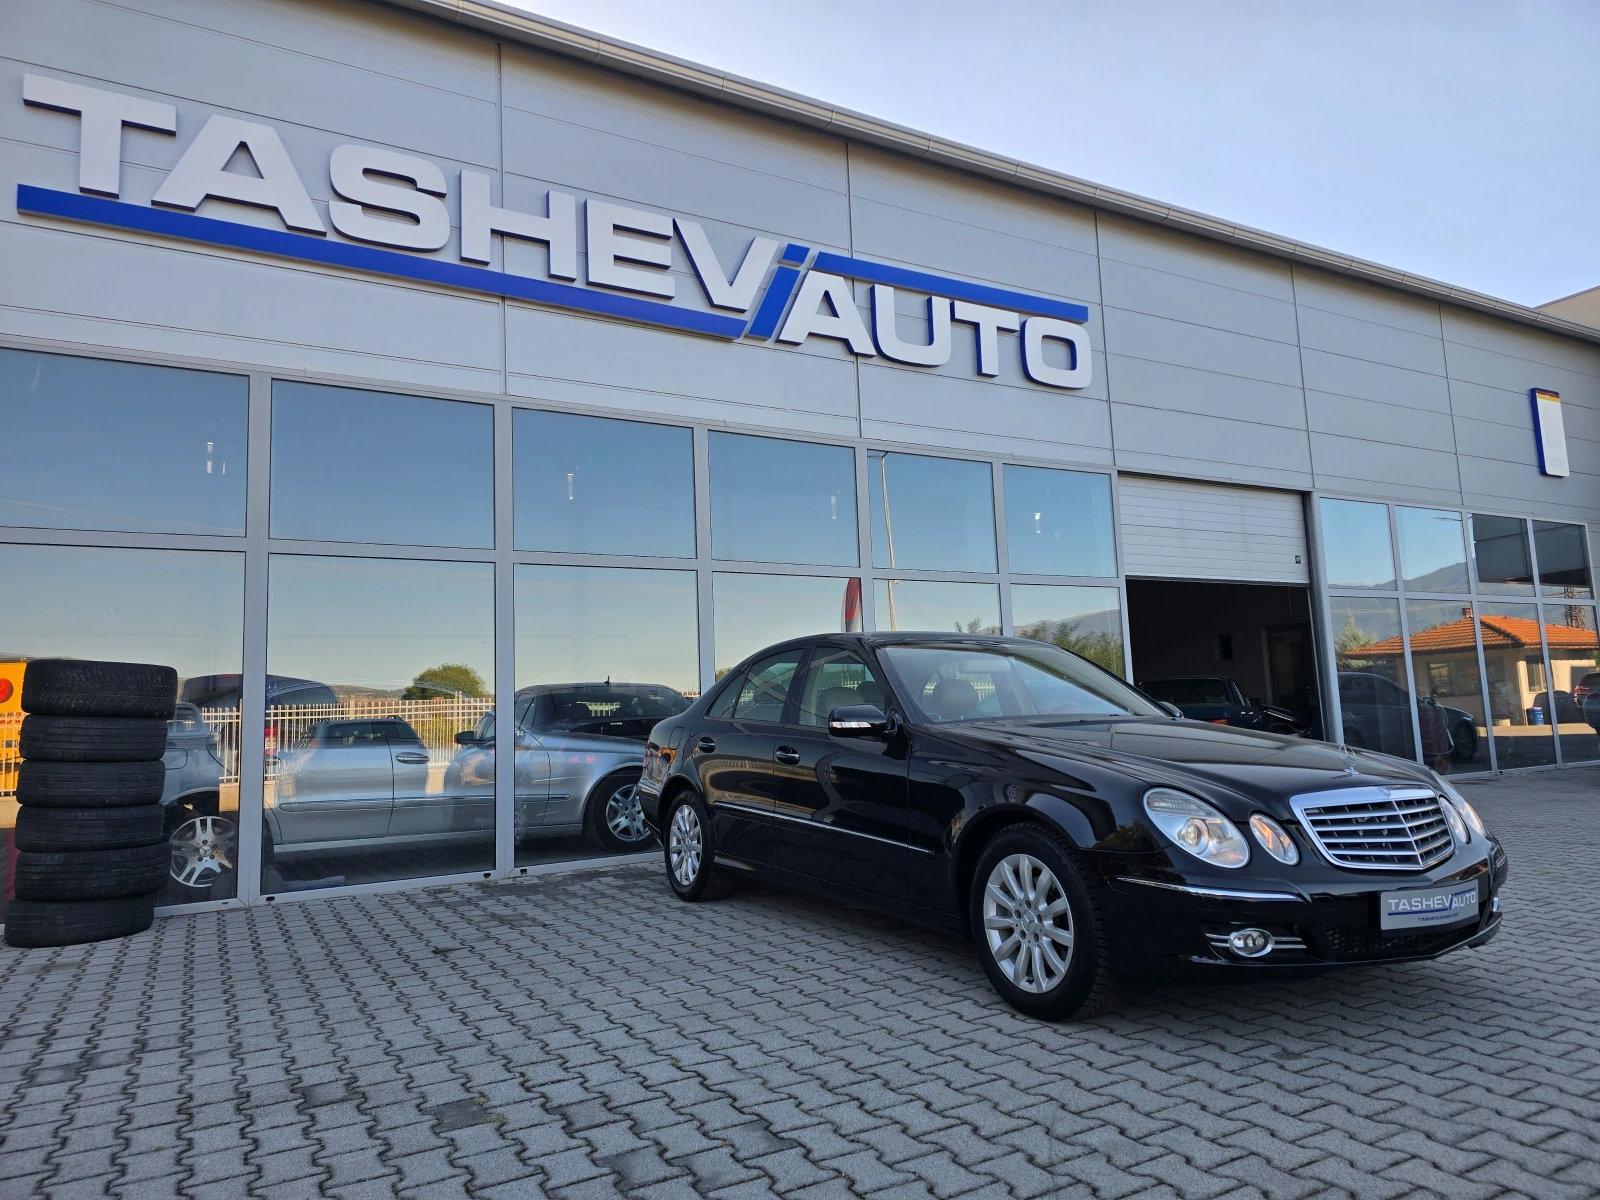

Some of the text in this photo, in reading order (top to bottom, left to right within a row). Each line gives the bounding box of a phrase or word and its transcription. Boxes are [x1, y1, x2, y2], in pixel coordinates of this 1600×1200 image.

[22, 73, 1093, 390] TASHEV AUTO
[1387, 891, 1477, 912] TASHEV AUTO
